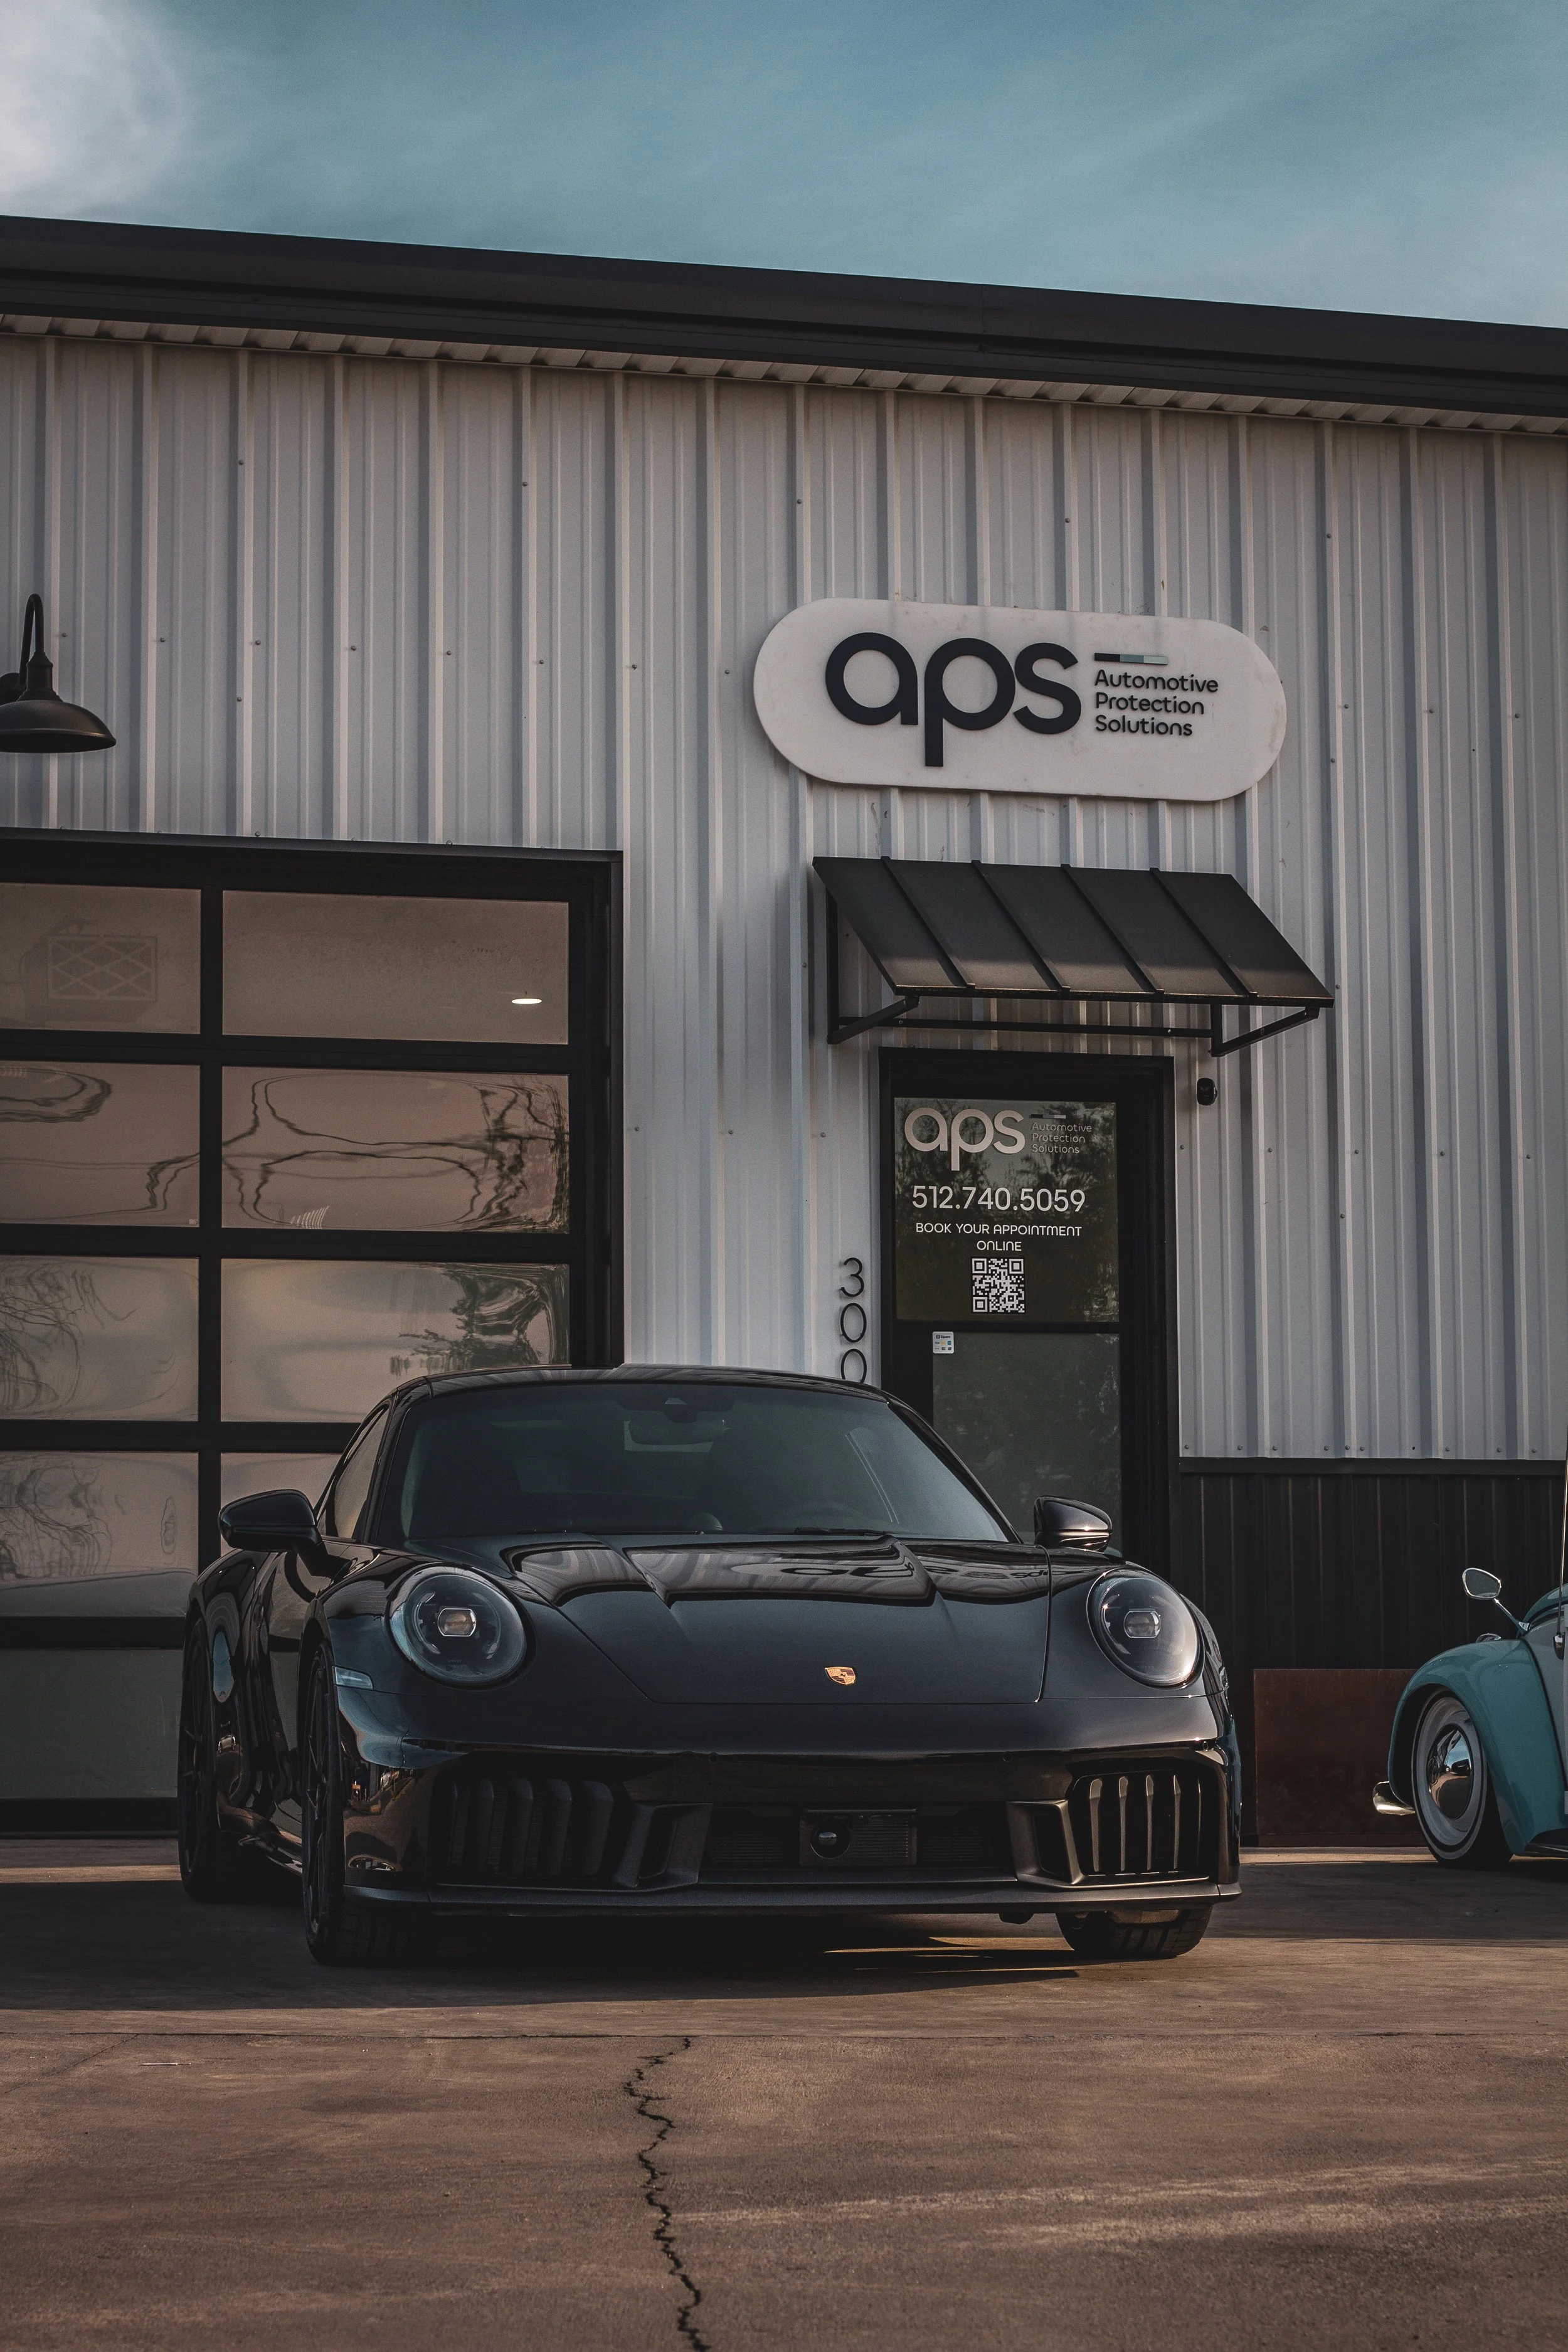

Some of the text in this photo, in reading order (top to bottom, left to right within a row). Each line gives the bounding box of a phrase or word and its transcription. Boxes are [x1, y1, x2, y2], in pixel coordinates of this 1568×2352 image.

[1094, 669, 1219, 692] Automotive
[825, 632, 1082, 766] aps
[1096, 692, 1204, 714] Protection
[1096, 714, 1193, 736] Solutions
[1032, 1122, 1092, 1132] Automotive
[1032, 1133, 1086, 1143] Protection
[904, 1107, 1025, 1171] aps
[1032, 1143, 1079, 1153] Solutions
[912, 1185, 1086, 1212] 512.740.5059
[916, 1222, 1082, 1236] BOOK YOUR APPOINTMENT
[977, 1241, 1022, 1251] ONLINE
